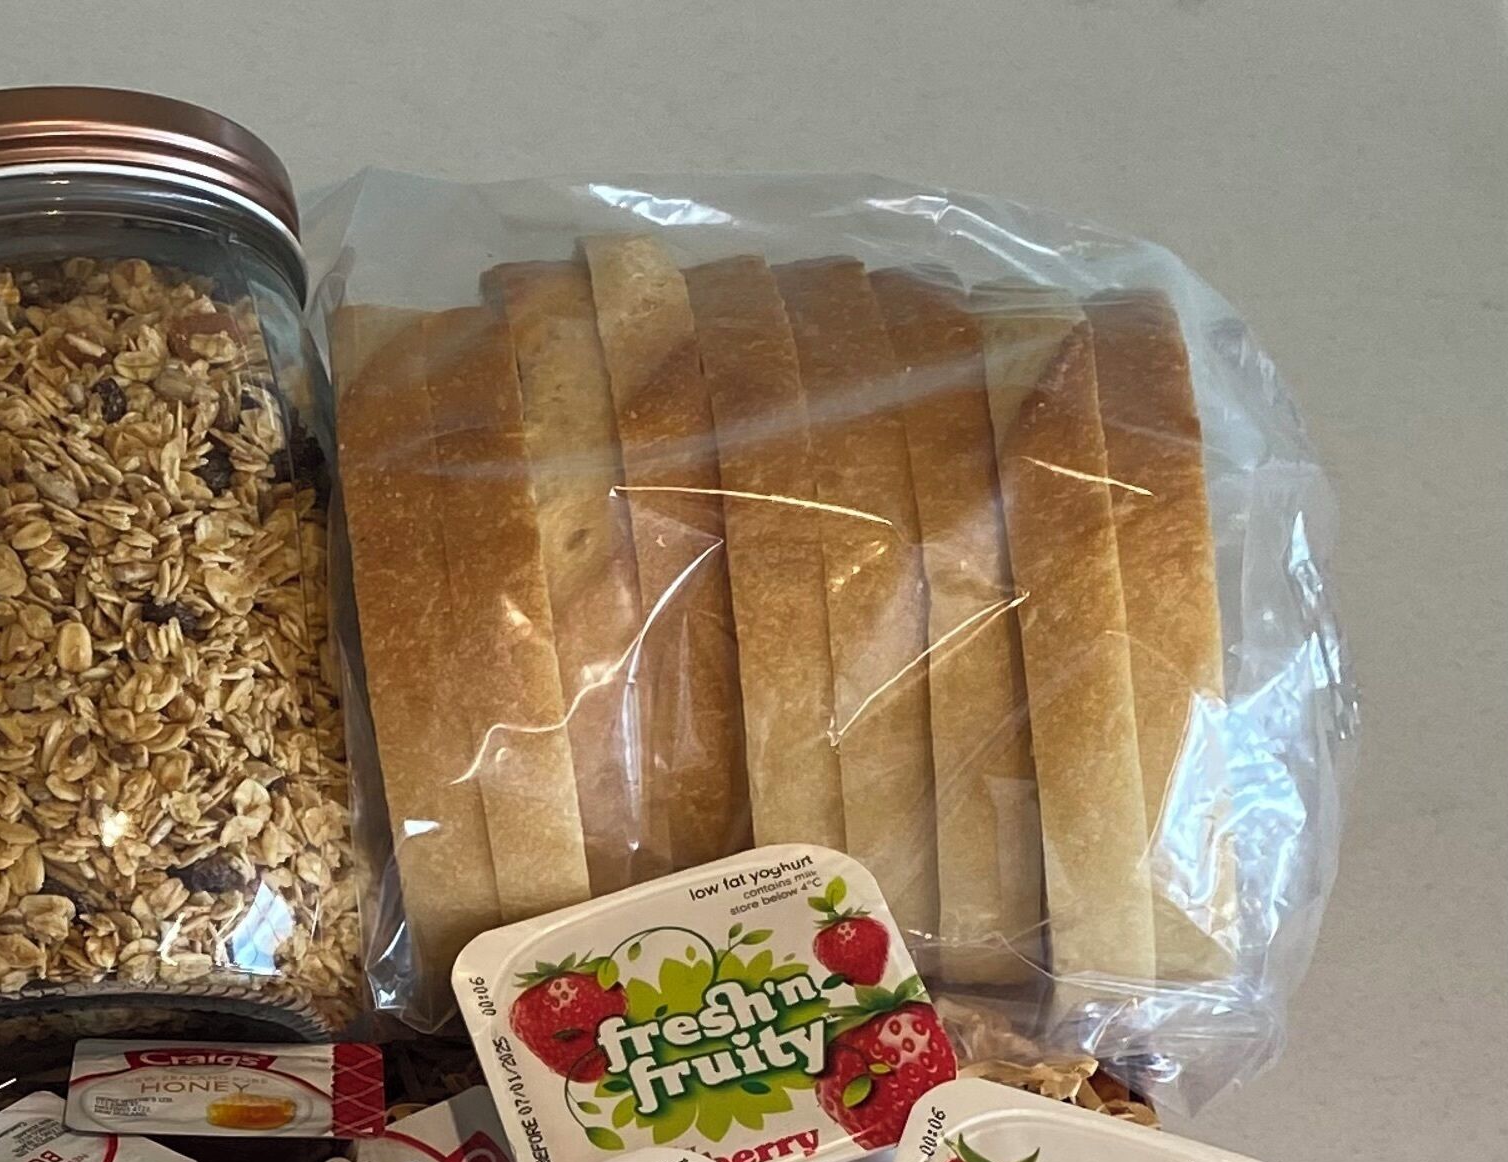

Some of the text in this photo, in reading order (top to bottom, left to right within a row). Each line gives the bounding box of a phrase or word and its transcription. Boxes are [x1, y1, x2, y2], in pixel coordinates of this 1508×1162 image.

[689, 883, 718, 901] low
[749, 855, 813, 885] yoghurt
[743, 878, 792, 899] contains
[730, 901, 759, 915] store
[761, 888, 797, 905] below
[597, 974, 817, 1073] fresh'n
[139, 1051, 262, 1067] Craig's
[493, 1036, 533, 1115] 07/01/2025
[629, 1017, 827, 1114] fruity
[141, 1081, 251, 1093] HONEY
[919, 1107, 946, 1157] 00:06
